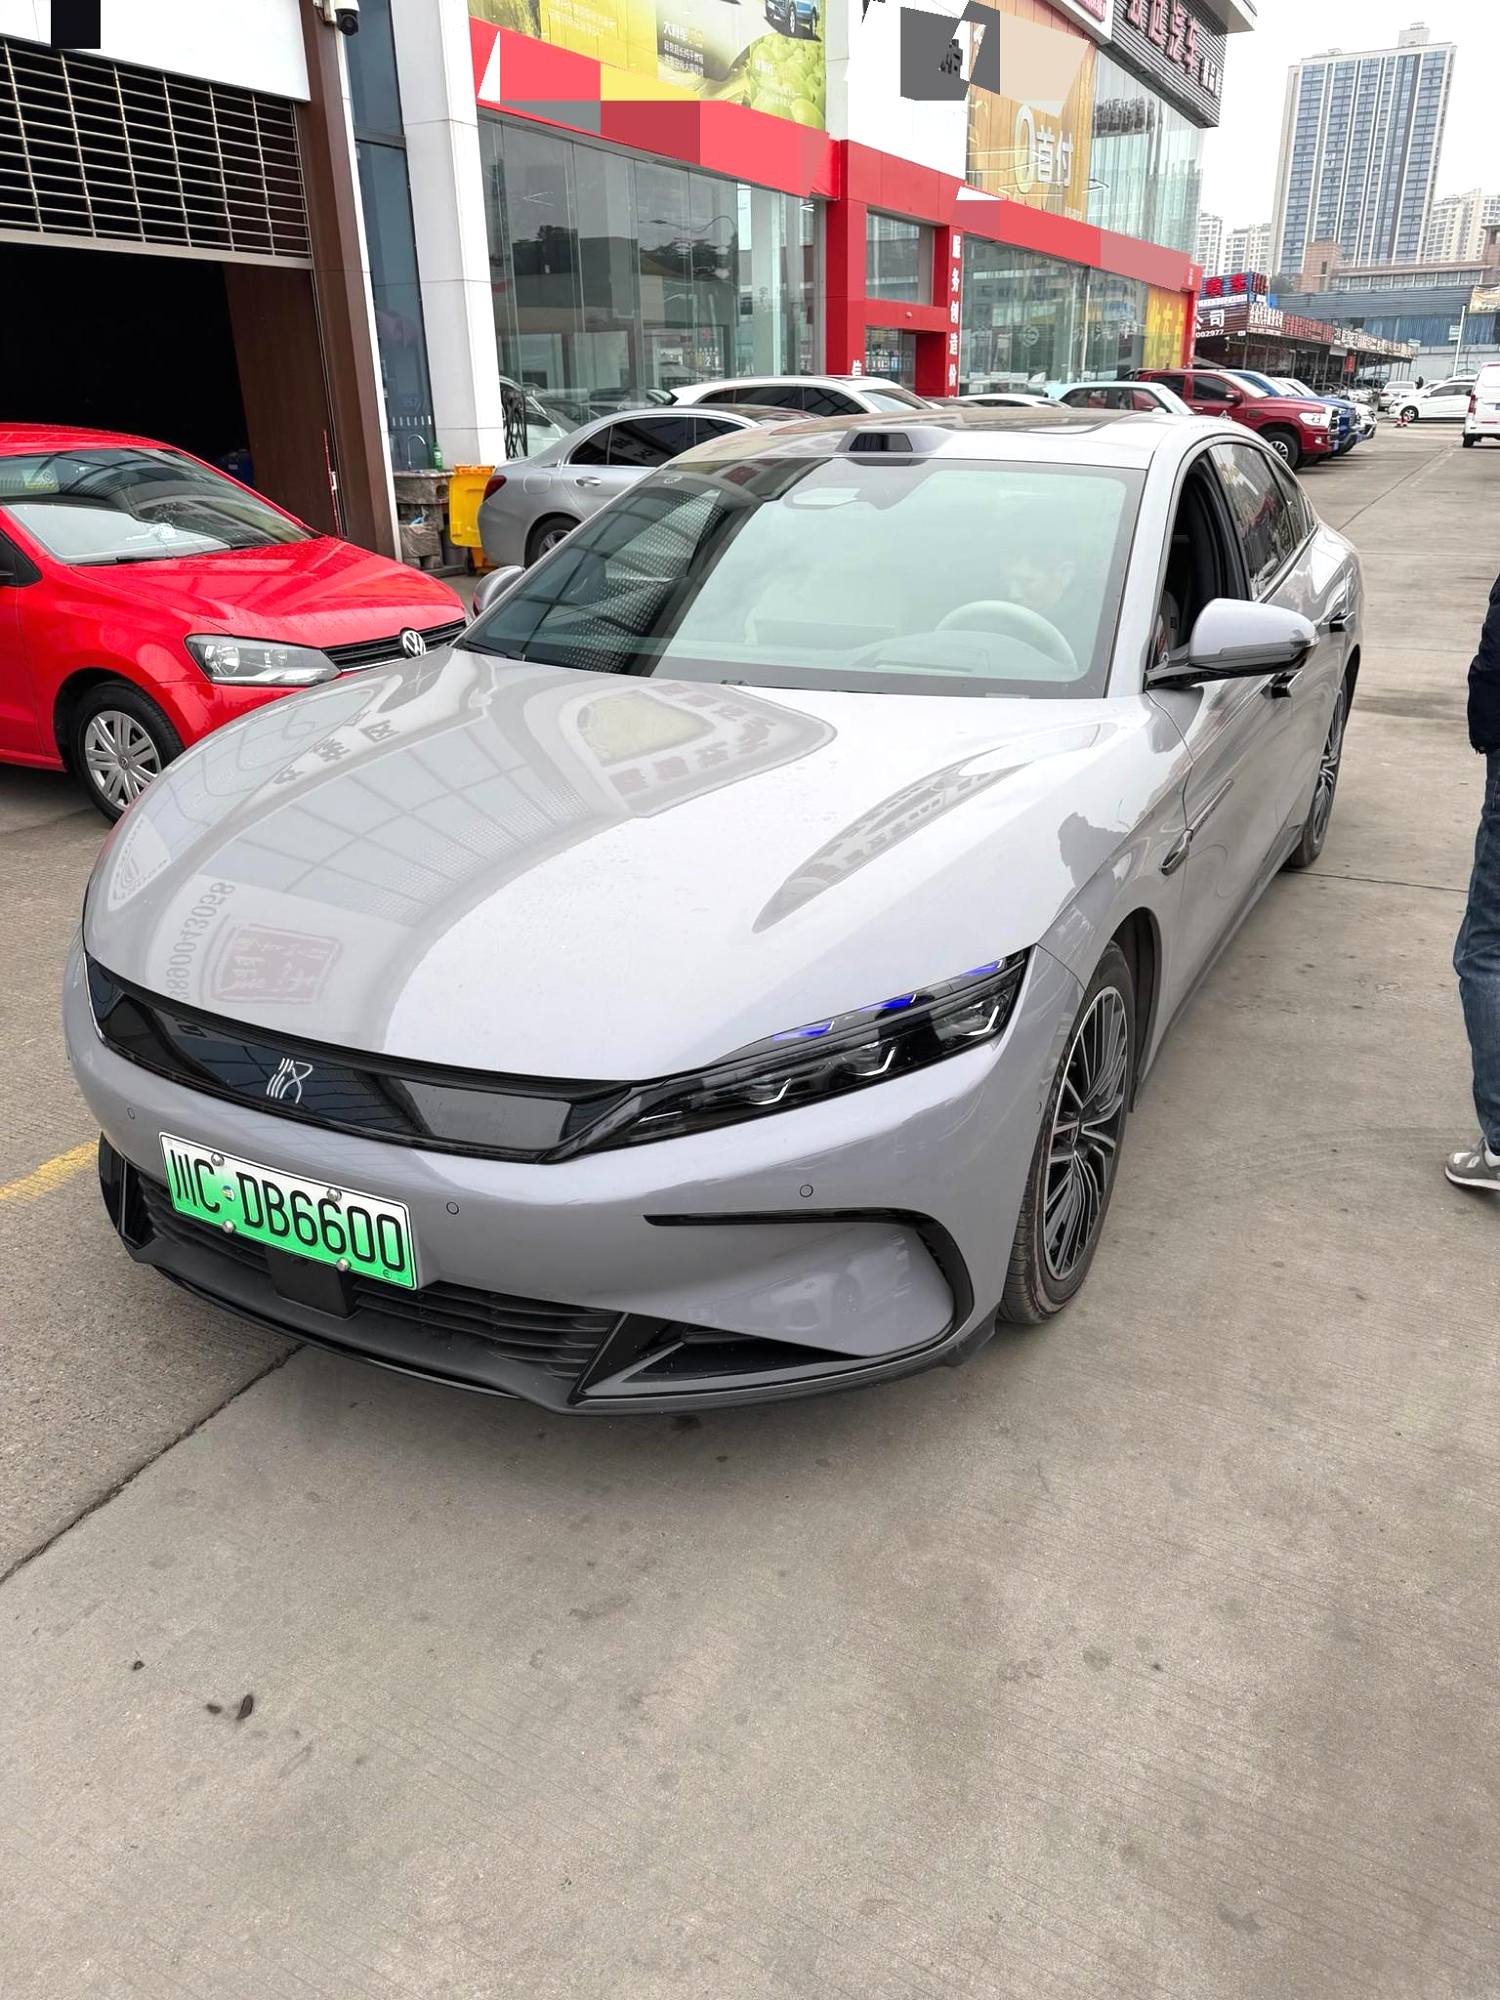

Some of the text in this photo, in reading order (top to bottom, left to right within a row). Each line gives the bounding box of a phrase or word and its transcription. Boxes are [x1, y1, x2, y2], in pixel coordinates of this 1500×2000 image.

[948, 234, 961, 399] 服务创造价
